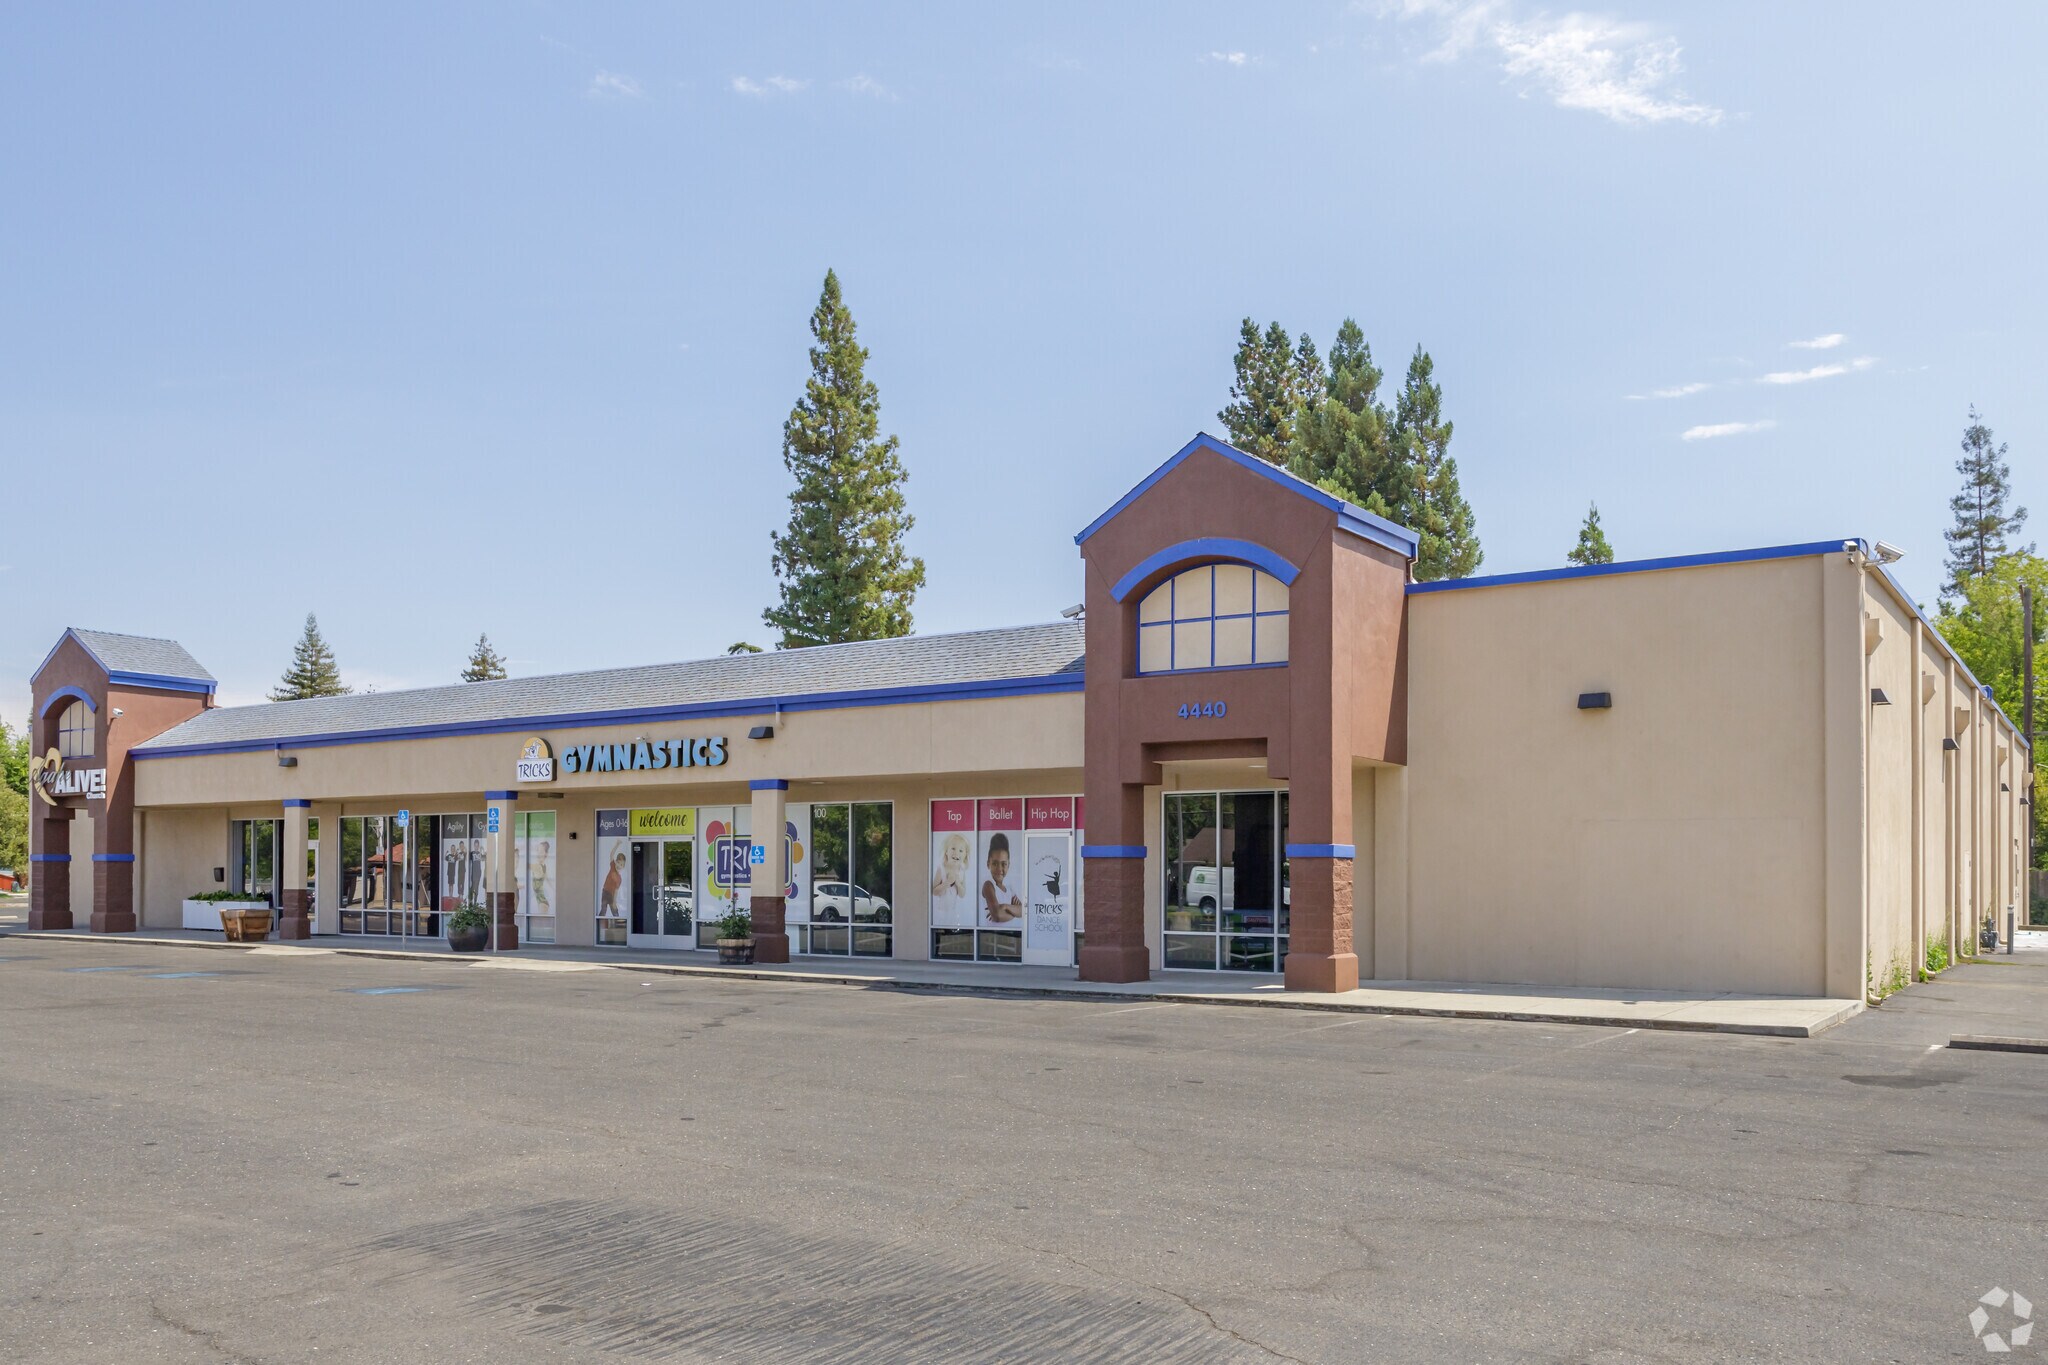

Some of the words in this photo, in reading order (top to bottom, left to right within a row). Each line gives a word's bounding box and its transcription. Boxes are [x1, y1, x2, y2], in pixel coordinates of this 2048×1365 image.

[1177, 700, 1227, 719] 4440
[560, 736, 726, 774] GYMNASTICS
[518, 762, 551, 778] TRICKS
[55, 768, 107, 794] ALIVE!
[639, 810, 688, 828] welcome
[814, 808, 827, 818] 100
[947, 810, 962, 824] Tap
[989, 808, 1014, 820] Ballet
[1031, 808, 1048, 822] Hip
[1050, 808, 1070, 821] Hop
[447, 820, 465, 833] Agility
[600, 819, 615, 830] Ages
[720, 845, 752, 871] TRI
[1034, 904, 1063, 915] TRICKS
[1036, 916, 1060, 924] DANCE
[1034, 924, 1063, 932] SCHOOL
